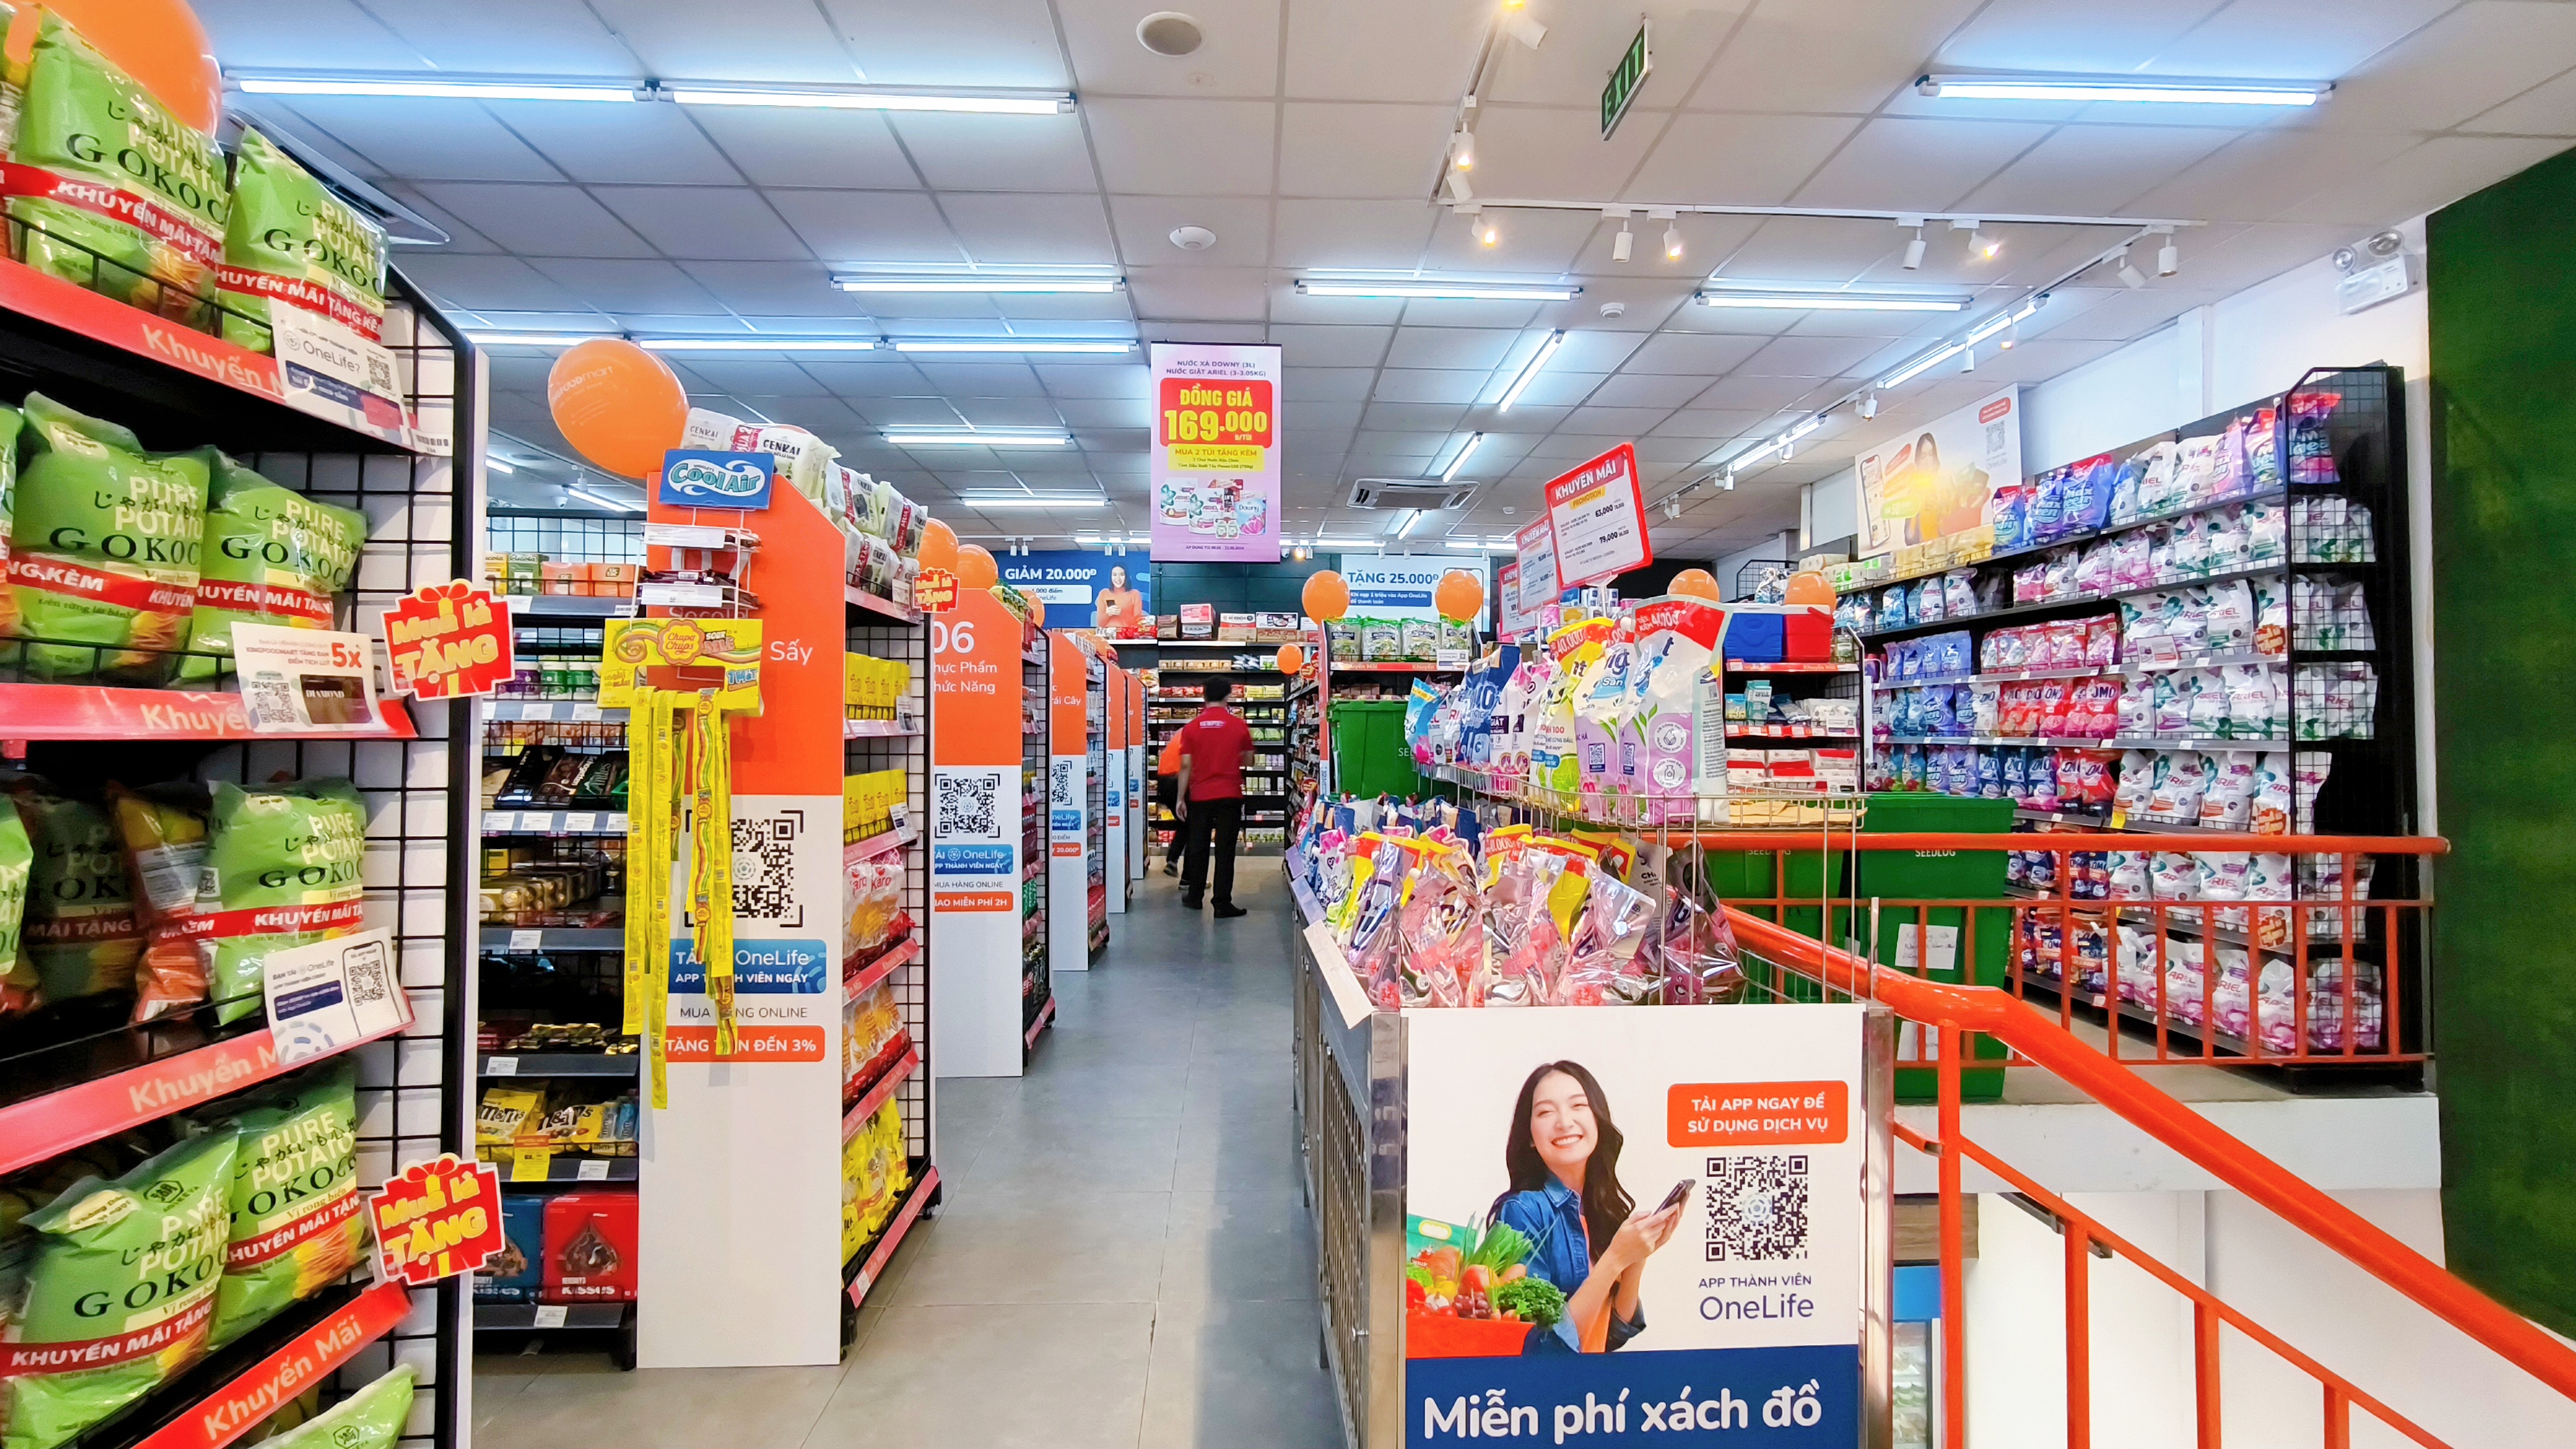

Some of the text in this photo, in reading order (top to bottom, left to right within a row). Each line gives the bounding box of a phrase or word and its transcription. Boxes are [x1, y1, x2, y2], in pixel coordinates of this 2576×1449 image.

[1605, 36, 1642, 125] EXIT
[57, 181, 156, 227] KHUYẾN
[313, 217, 378, 273] POTAT
[216, 269, 282, 292] HUYẾN
[287, 283, 325, 306] MÃI
[142, 323, 261, 390] Khuyến
[1180, 383, 1253, 407] ĐỒNG GIÁ
[1164, 410, 1268, 441] 169.000
[1202, 447, 1215, 456] TÚI
[1217, 448, 1239, 457] TẶNG
[1596, 458, 1616, 481] MÃI
[130, 476, 199, 509] PURE
[1572, 489, 1602, 508] PROMOTION
[286, 499, 345, 541] PURE
[1239, 504, 1259, 513] Downy
[1595, 504, 1614, 517] 63,000
[1599, 531, 1618, 545] 79,000
[45, 566, 105, 591] KÈM
[1005, 565, 1042, 580] GIẢM
[1347, 569, 1385, 586] TẶNG
[196, 585, 302, 609] HUYẾN MÃI
[391, 613, 460, 645] Mua
[667, 632, 697, 643] Chupa
[395, 634, 499, 684] TẶNG
[665, 641, 695, 655] Chups
[770, 639, 813, 665] Sấy
[934, 660, 997, 676] hực Phẩm
[934, 680, 996, 695] hức Năng
[1064, 695, 1081, 706] Cây
[308, 812, 354, 837] PURE
[963, 849, 1005, 859] OneLife
[871, 874, 892, 890] Karo
[952, 880, 974, 888] HÀNG
[953, 896, 975, 906] MIỄN
[978, 897, 993, 906] PHÍ
[254, 905, 352, 926] KHUYẾN MÃI
[736, 949, 810, 966] OneLife
[675, 973, 700, 983] APP
[747, 971, 774, 983] VIÊN
[776, 973, 809, 983] NGAY
[680, 1007, 808, 1018] MUA ONLINE
[667, 1035, 710, 1056] TẶNG
[753, 1034, 787, 1052] ĐẾN
[791, 1039, 817, 1052] 3%
[129, 1052, 253, 1113] Khuyến
[1691, 1091, 1826, 1112] TẢI APP NGAY ĐỂ
[262, 1111, 336, 1158] PURE
[1687, 1116, 1829, 1137] SỬ DỤNG DỊCH VỤ
[252, 1132, 355, 1191] POTATO
[303, 1199, 326, 1216] rong
[379, 1190, 447, 1230] Mua
[299, 1209, 330, 1237] MÃI
[384, 1206, 488, 1267] TẶNG
[1698, 1270, 1813, 1289] APP THÀNH VIÊN
[1700, 1293, 1815, 1321] OneLife
[10, 1301, 214, 1367] KHUYẾN MÃI TẶNG
[203, 1314, 363, 1441] Khuyến Mãi
[1424, 1378, 1822, 1445] Miễn phí xách đồ
